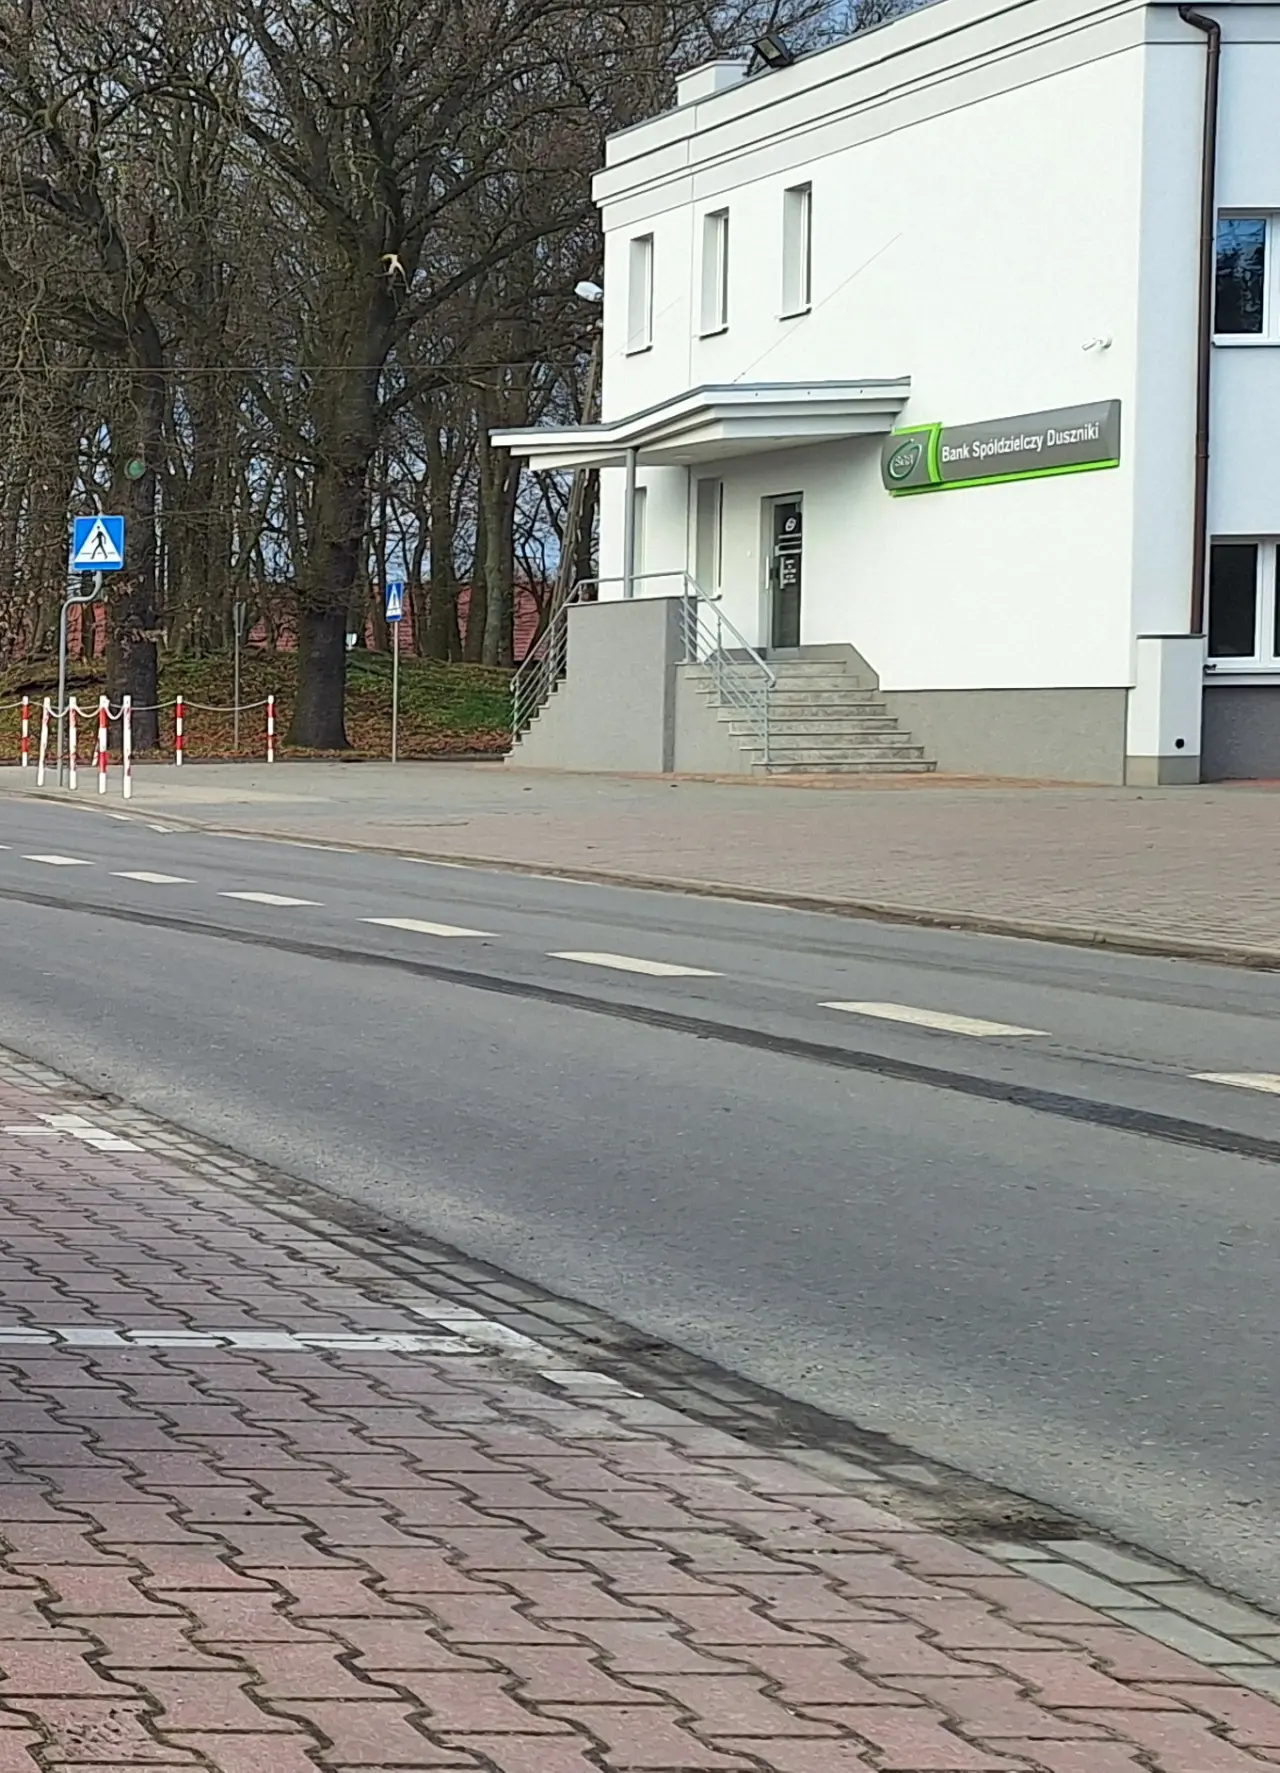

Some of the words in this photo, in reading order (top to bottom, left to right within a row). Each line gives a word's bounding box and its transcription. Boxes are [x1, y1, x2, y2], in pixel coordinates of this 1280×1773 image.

[942, 444, 971, 463] Bank
[972, 434, 1044, 461] Spółdzielczy
[1046, 422, 1100, 447] Duszniki
